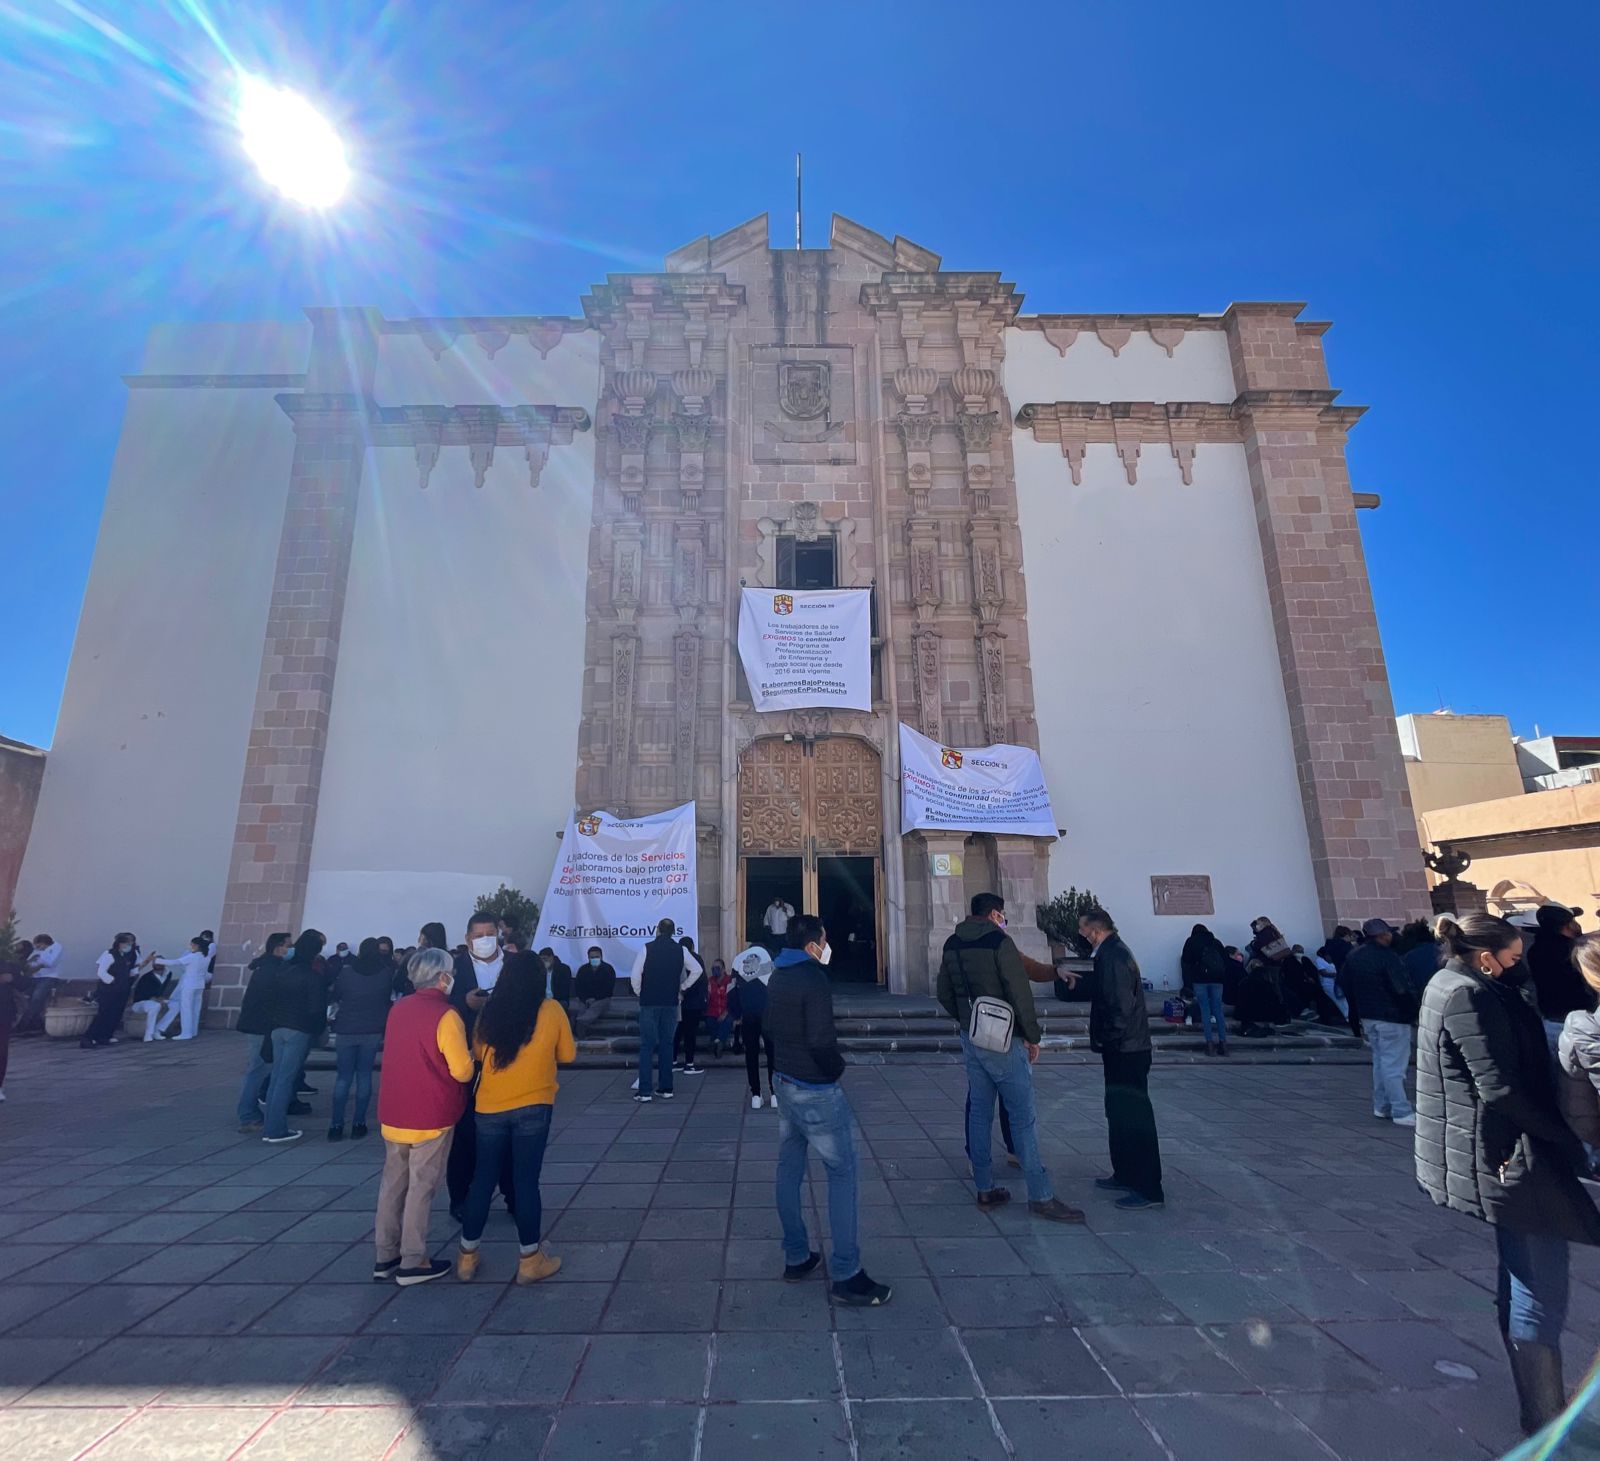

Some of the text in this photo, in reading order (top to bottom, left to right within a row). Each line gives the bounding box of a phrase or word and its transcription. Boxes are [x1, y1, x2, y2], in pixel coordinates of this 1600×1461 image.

[775, 647, 832, 655] Profesionalización
[761, 680, 846, 689] #LaboramosBajoProtesta
[761, 687, 847, 697] #SeguimosEnPieDeLucha
[904, 765, 915, 775] Los
[916, 771, 956, 791] trabajadores
[968, 786, 979, 795] los
[1023, 785, 1044, 795] Salud
[903, 772, 936, 790] EXIGIMOS
[944, 790, 990, 802] continuidad
[1002, 794, 1038, 804] Programa
[915, 784, 975, 808] Profesionalización
[977, 802, 986, 810] de
[925, 797, 945, 807] social
[610, 853, 622, 862] de
[625, 853, 639, 862] los
[641, 851, 686, 862] Servicios
[575, 863, 623, 874] laboramos
[625, 865, 646, 876] bajo
[582, 875, 617, 884] respeto
[628, 876, 663, 885] nuestra
[666, 873, 688, 883] CGT
[575, 886, 641, 897] medicamentos
[643, 889, 650, 898] y
[651, 886, 688, 897] equipos
